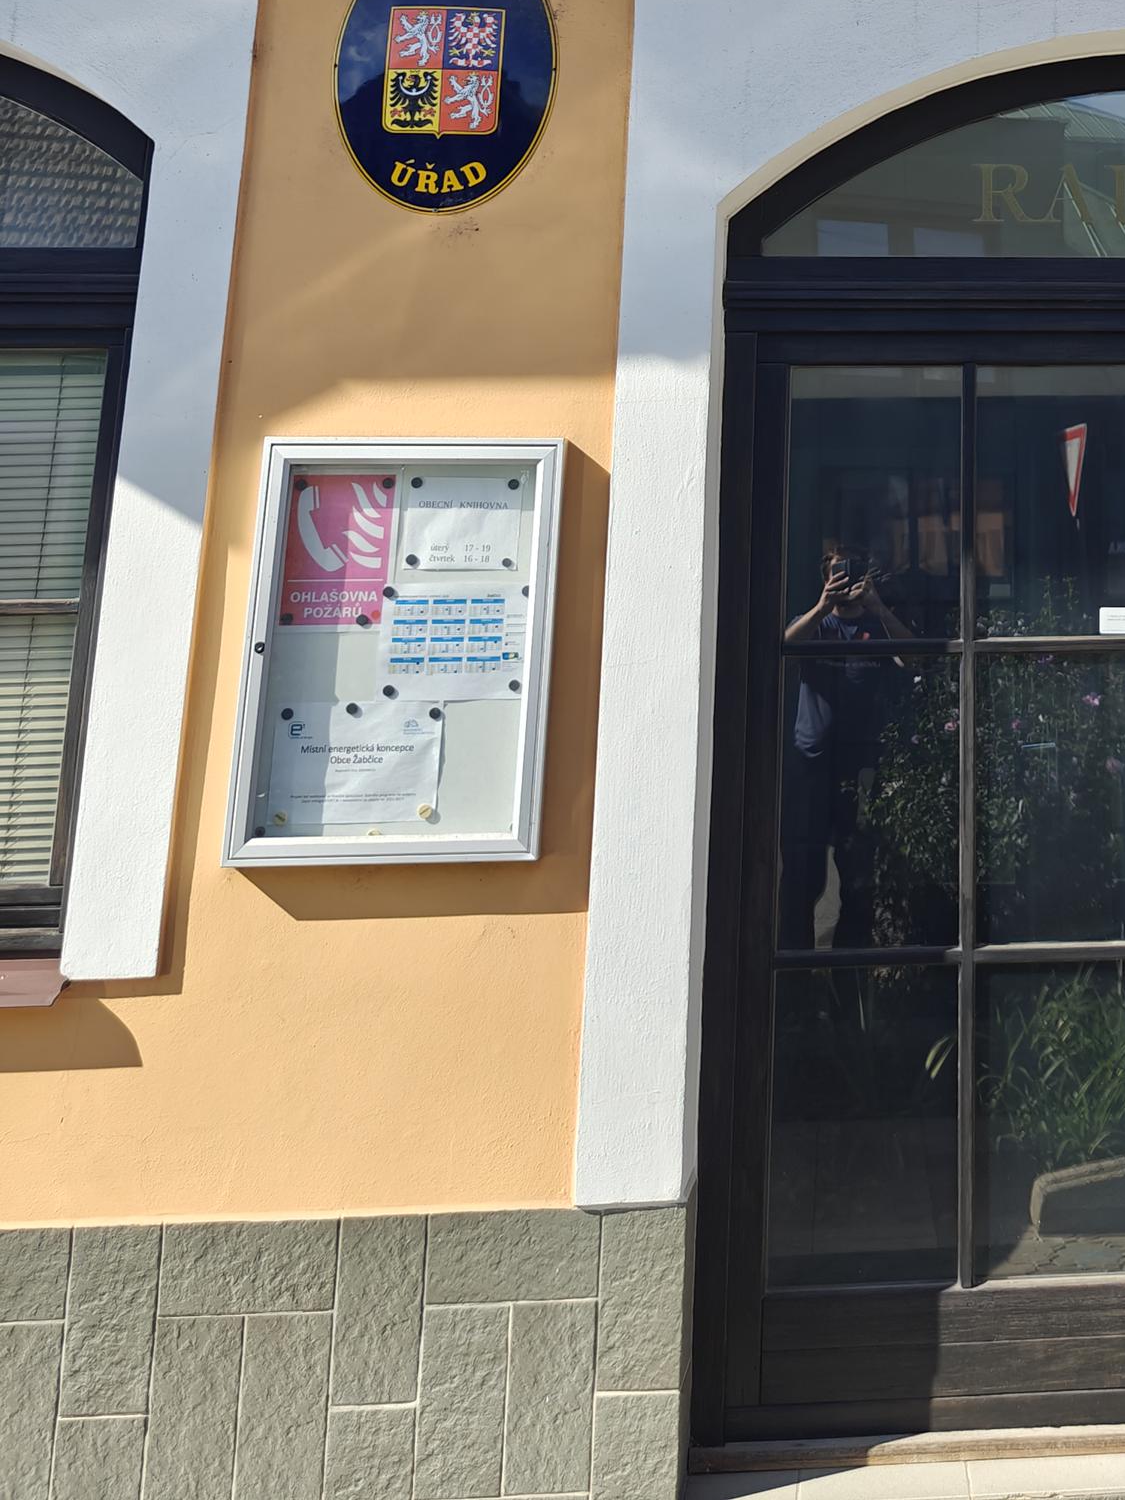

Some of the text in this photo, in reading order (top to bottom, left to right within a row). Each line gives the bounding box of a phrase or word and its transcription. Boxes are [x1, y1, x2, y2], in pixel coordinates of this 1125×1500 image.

[390, 159, 487, 194] ÚŘAD
[418, 500, 509, 510] OBECNÍ KNIHOVNA
[430, 543, 450, 553] úterý
[464, 544, 474, 552] 17
[482, 544, 491, 552] 19
[429, 554, 456, 563] čtvrtek
[464, 555, 473, 563] 16
[290, 589, 378, 603] OHLAŠOVNA
[303, 603, 363, 618] POŽÁRŮ
[300, 743, 415, 755] Místní energetická koncepce
[330, 754, 384, 764] Obce Žabčice
